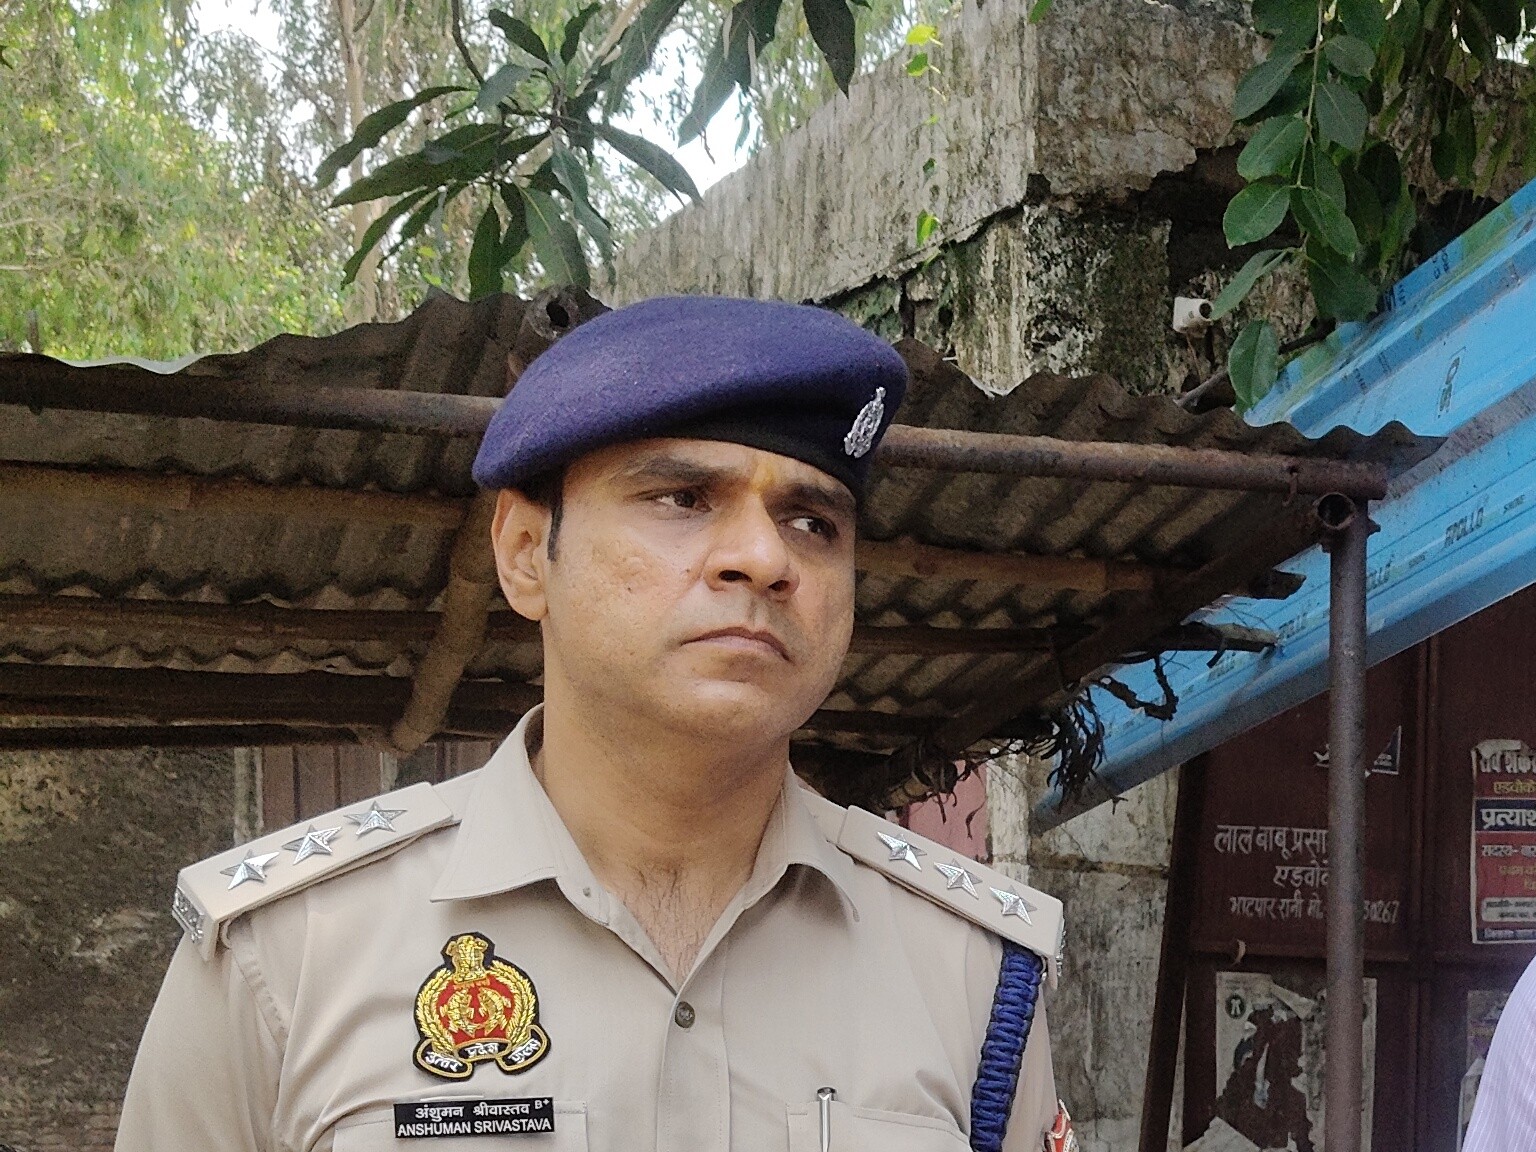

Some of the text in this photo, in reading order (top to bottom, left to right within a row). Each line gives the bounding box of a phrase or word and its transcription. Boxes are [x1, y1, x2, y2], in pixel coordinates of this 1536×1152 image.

[1214, 825, 1329, 860] लाल बाबू प्रसा
[415, 1104, 464, 1122] अंशुमन
[473, 1103, 530, 1117] श्रीवास्तव
[397, 1118, 552, 1137] ANSHUMAN SRIVASTAVA
